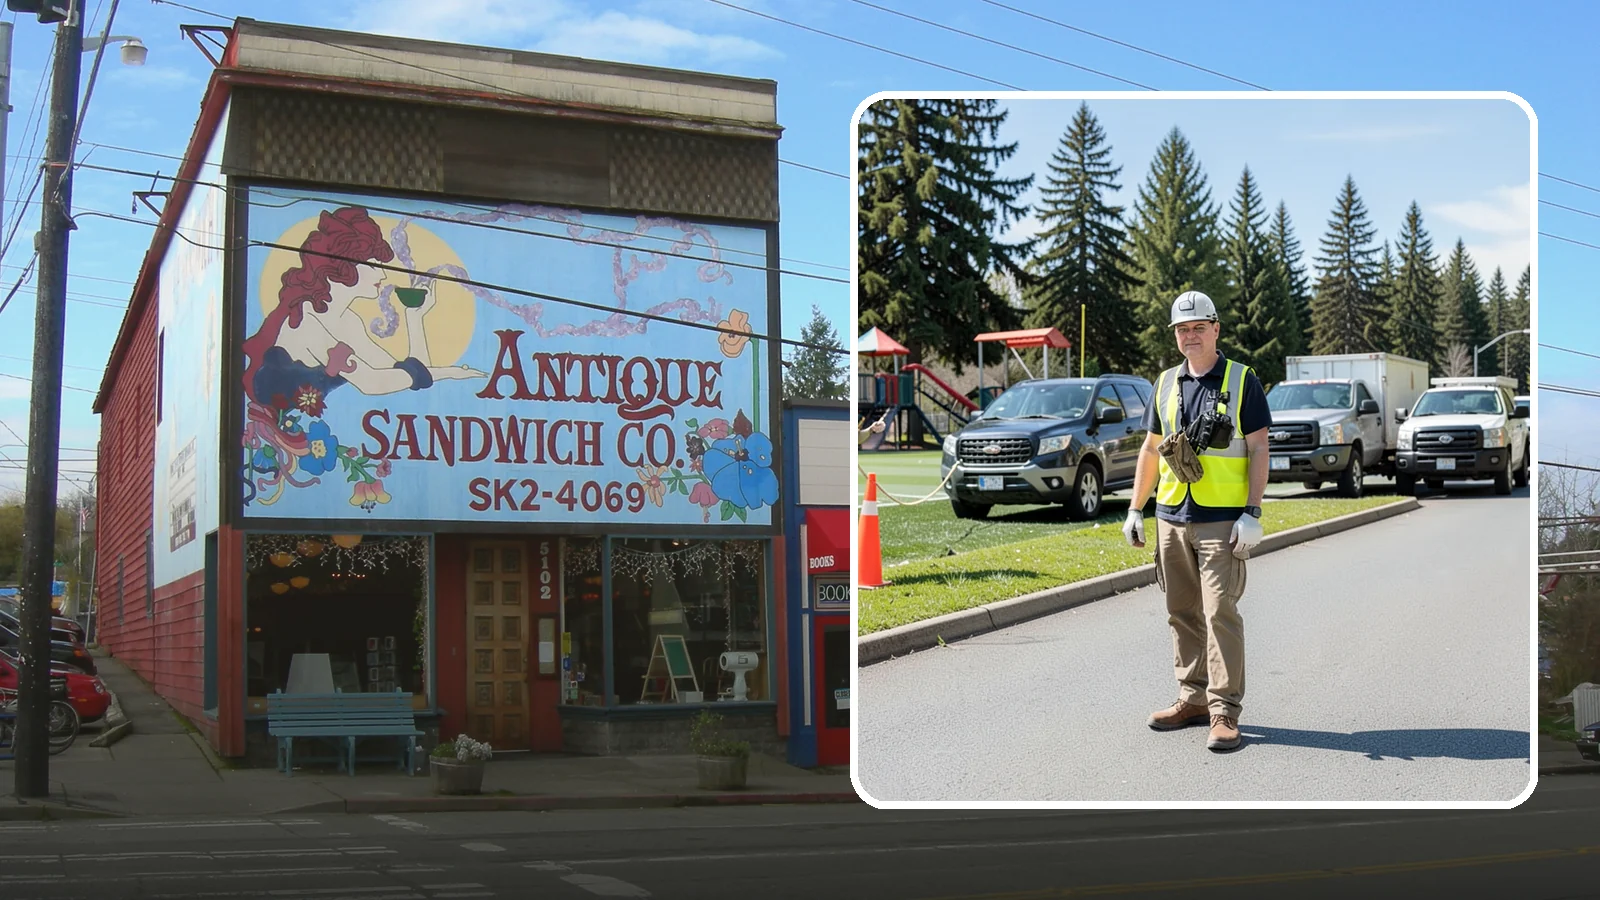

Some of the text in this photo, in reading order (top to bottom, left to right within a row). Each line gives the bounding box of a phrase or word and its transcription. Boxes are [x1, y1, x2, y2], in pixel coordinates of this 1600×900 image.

[361, 408, 685, 469] SANDWICH CO.
[468, 477, 646, 513] SK2-4069
[540, 541, 552, 600] 5102
[809, 555, 835, 569] BOOKS
